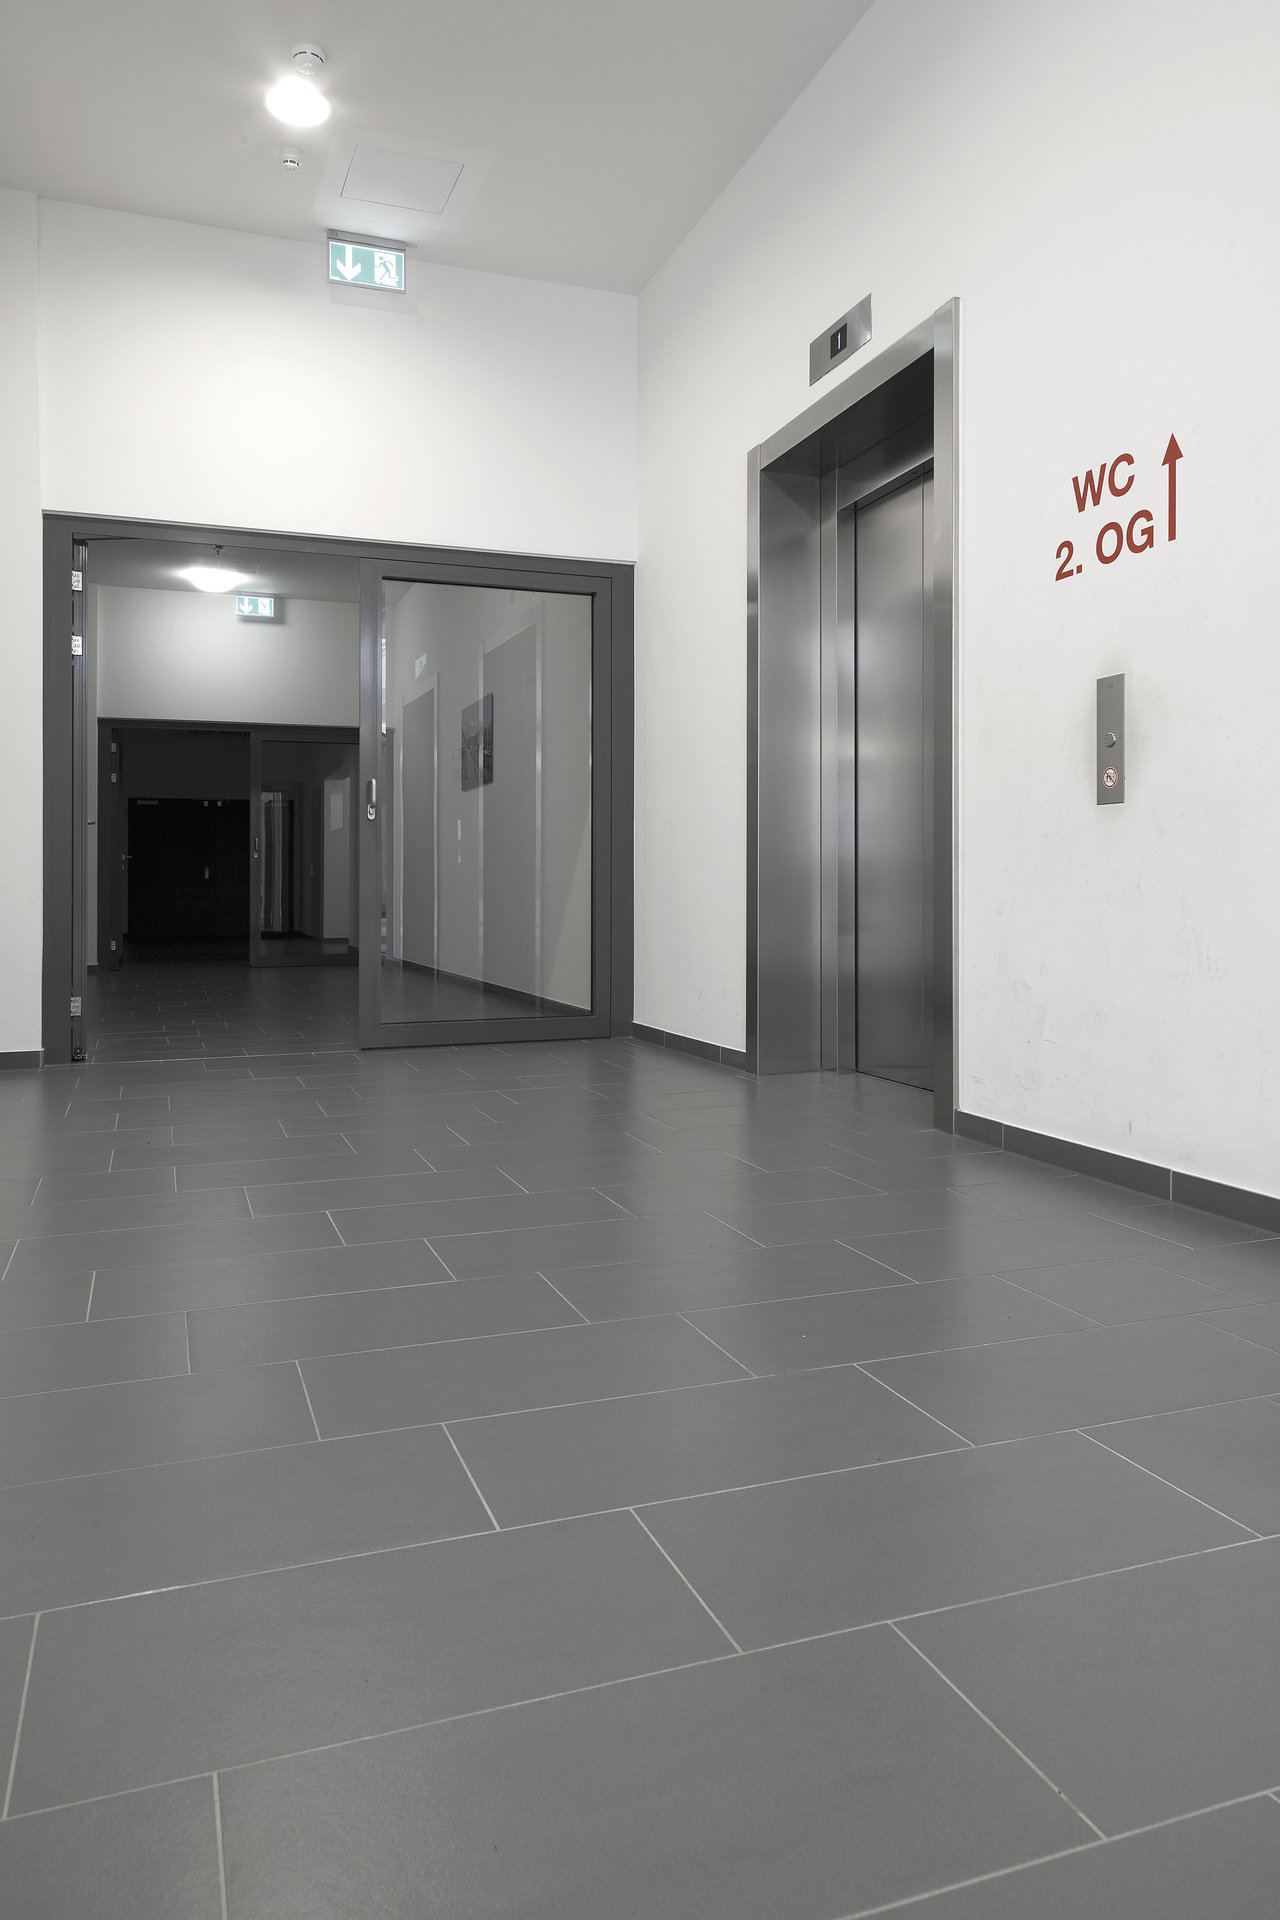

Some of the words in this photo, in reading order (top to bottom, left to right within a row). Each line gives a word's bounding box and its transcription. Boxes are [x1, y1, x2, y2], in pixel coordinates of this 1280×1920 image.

[1072, 453, 1135, 513] WC
[1055, 540, 1083, 582] 2.
[1096, 509, 1154, 565] OG
